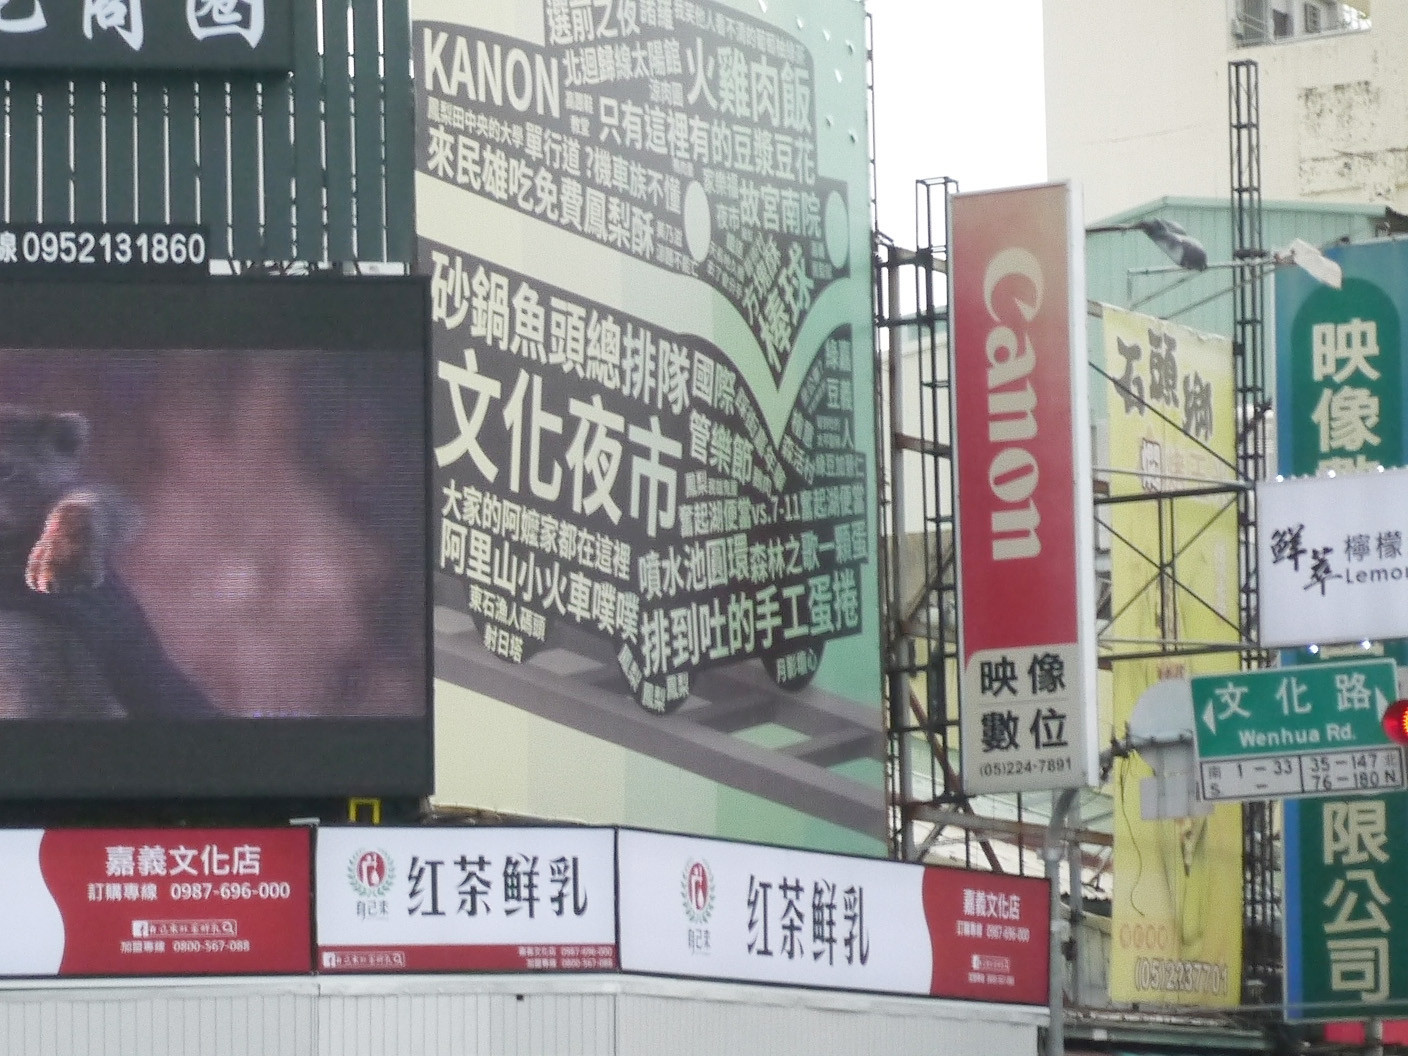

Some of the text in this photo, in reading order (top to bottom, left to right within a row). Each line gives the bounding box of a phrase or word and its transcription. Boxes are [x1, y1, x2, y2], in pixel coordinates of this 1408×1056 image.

[423, 27, 561, 120] KANON
[686, 36, 813, 136] 火雞肉飯
[426, 124, 655, 262] 來民雄吃免費鳳梨酥
[431, 250, 692, 415] 砂鍋魚頭總排隊
[983, 246, 1043, 560] Canon
[1311, 317, 1382, 475] 映像
[434, 347, 685, 539] 文化夜市
[1346, 566, 1408, 584] Lemo
[979, 652, 1067, 698] 映像
[1214, 672, 1372, 721] 文化路
[979, 707, 1069, 754] 數位
[1238, 722, 1357, 748] Wenhua Rd.
[105, 845, 261, 877] 嘉義文化店
[170, 882, 291, 900] 0987-696-000
[1321, 800, 1392, 1004] 限公司
